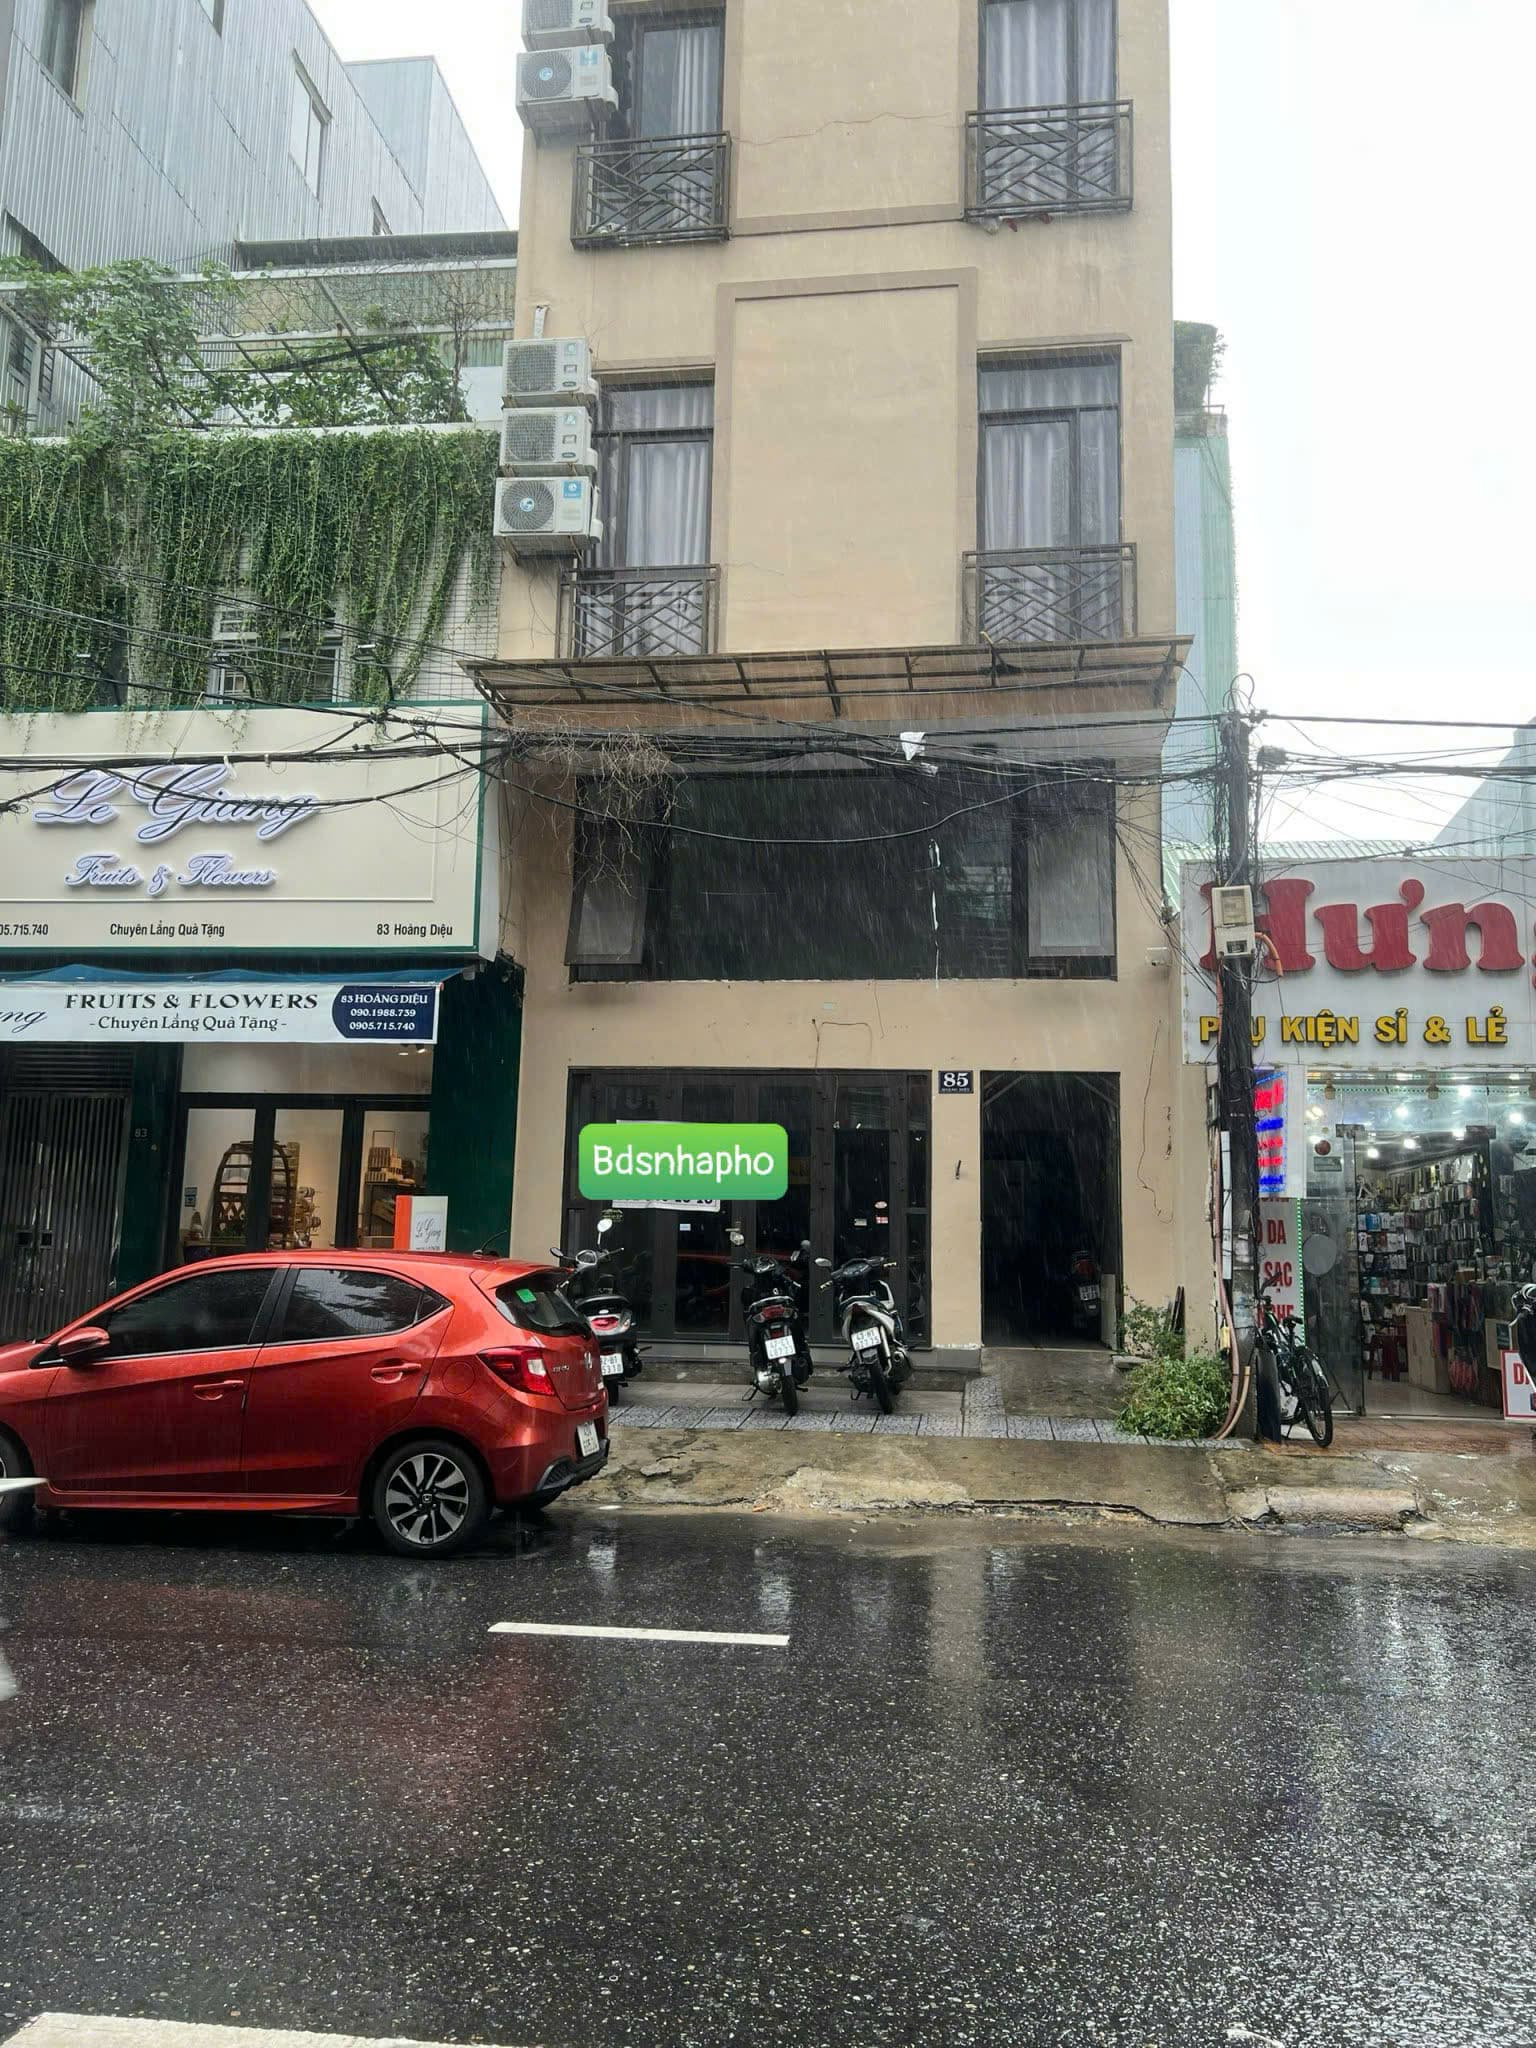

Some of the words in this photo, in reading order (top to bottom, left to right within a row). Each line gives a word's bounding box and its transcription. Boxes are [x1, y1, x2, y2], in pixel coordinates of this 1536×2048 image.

[64, 853, 141, 886] Fruits
[148, 865, 170, 896] &
[177, 853, 276, 886] Flowers
[110, 923, 147, 938] Chuyên
[178, 923, 198, 936] Quà
[201, 923, 225, 938] Tặng
[376, 923, 390, 936] 83
[394, 923, 427, 938] Hoàng
[430, 923, 453, 939] Diệu
[65, 993, 156, 1009] FRUITS
[163, 993, 180, 1009] &
[188, 993, 319, 1009] FLOWERS
[340, 994, 354, 1004] 83
[400, 992, 429, 1006] DIỆU
[350, 1008, 417, 1017] 090.1988.739
[98, 1015, 158, 1032] Chuyên
[202, 1015, 236, 1031] Quà
[240, 1015, 278, 1032] Tặng
[349, 1021, 416, 1031] 0905.715.740
[1200, 1016, 1266, 1047] PỤ
[1280, 1008, 1360, 1048] KIỆN
[1373, 1007, 1409, 1044] SỈ
[1423, 1015, 1452, 1044] &
[1465, 1005, 1509, 1044] LẺ
[943, 1072, 969, 1088] 85
